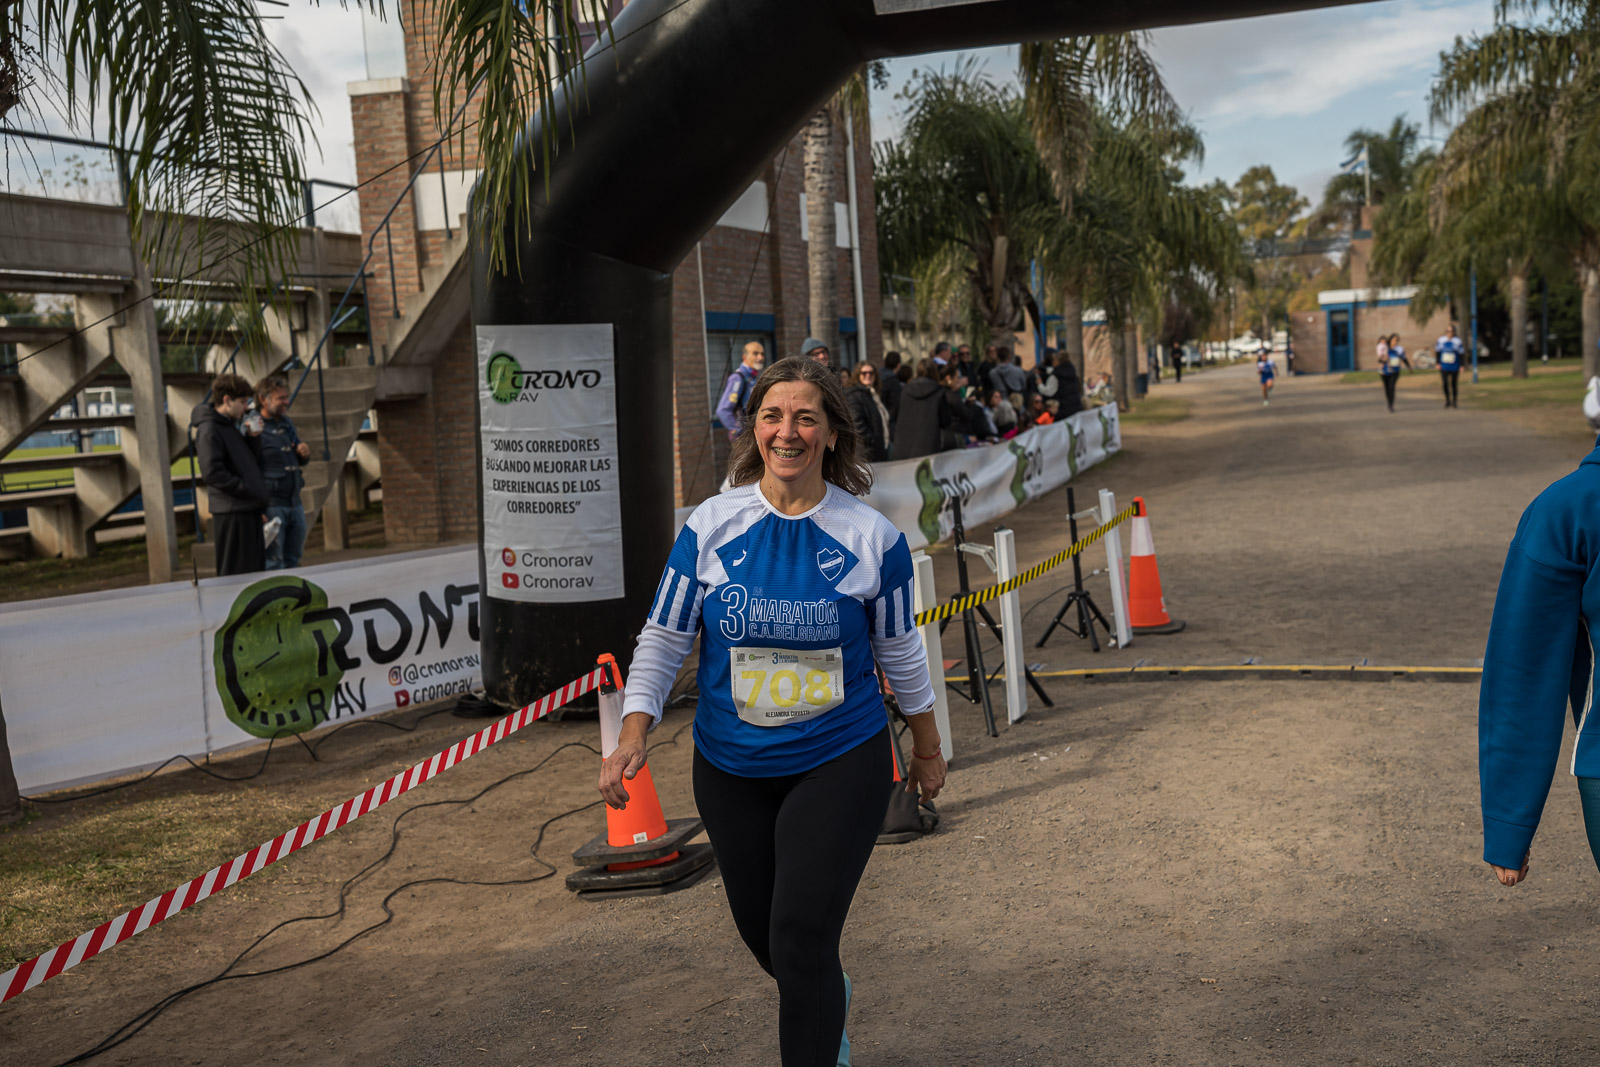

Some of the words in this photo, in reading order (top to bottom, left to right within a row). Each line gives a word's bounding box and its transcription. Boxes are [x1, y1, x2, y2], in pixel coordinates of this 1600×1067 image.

[509, 392, 539, 402] RAV
[526, 438, 600, 453] CORREDORES
[486, 457, 531, 473] BUSCANDO
[533, 459, 587, 473] MEJORAR
[590, 458, 611, 472] LAS
[492, 479, 559, 493] EXPERIENCIAS
[562, 481, 577, 493] DE
[580, 479, 601, 492] LOS
[521, 553, 594, 567] Cronorav
[522, 573, 595, 588] Cronorav
[720, 584, 747, 640] 3
[749, 598, 839, 625] MARATÓN
[771, 652, 779, 664] 3
[403, 654, 480, 684] @cronorav
[413, 677, 473, 704] cronorav
[741, 668, 832, 709] 708
[306, 677, 367, 725] RAV
